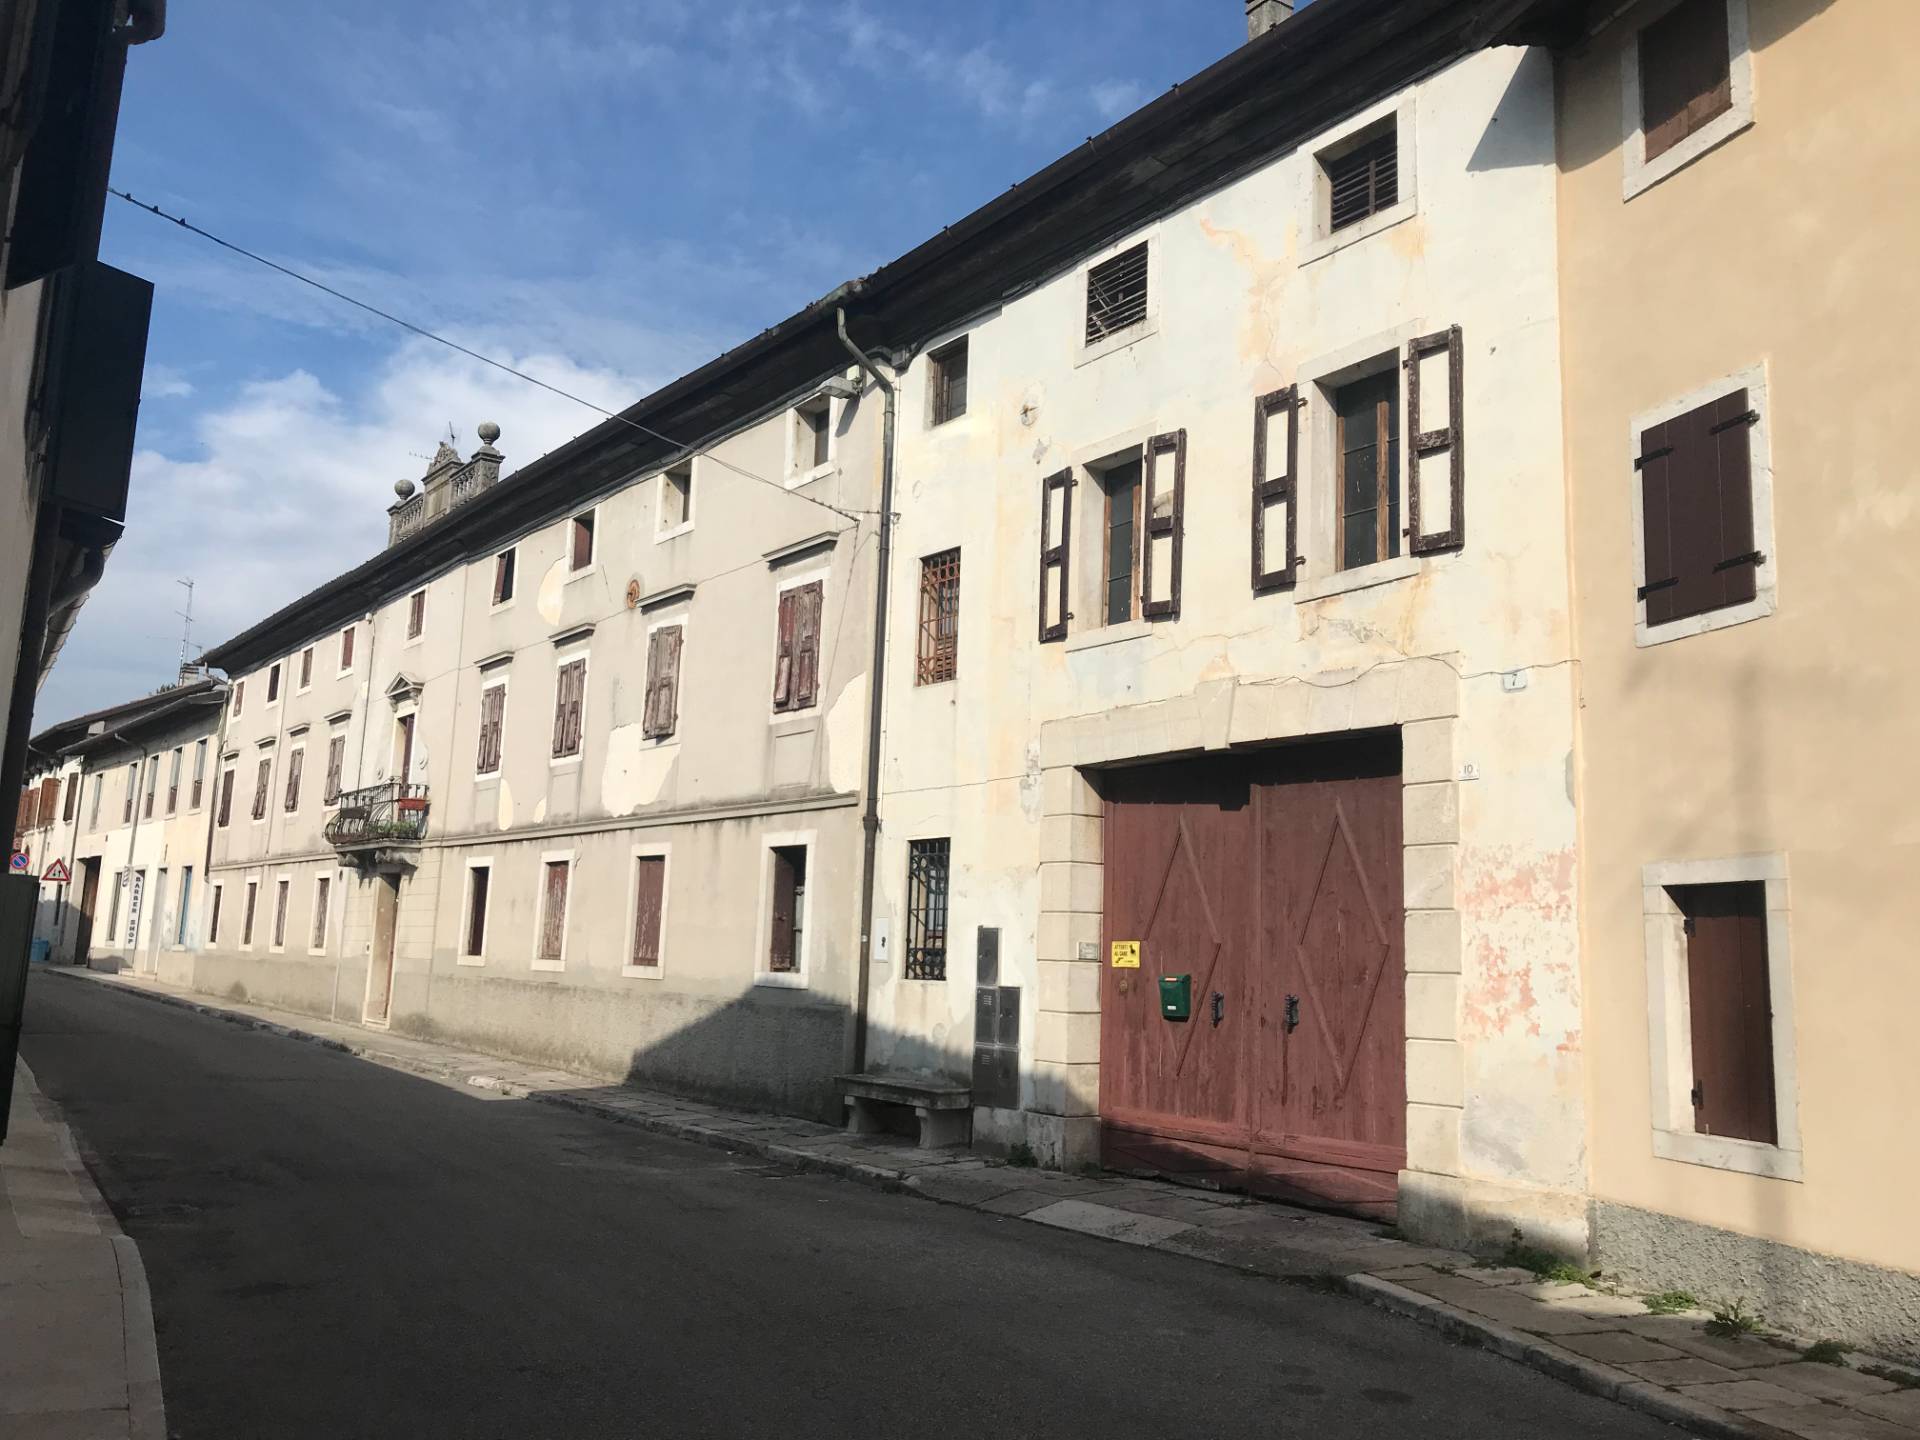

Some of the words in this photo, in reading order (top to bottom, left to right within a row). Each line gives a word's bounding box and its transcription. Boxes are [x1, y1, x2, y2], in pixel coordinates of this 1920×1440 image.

[1512, 673, 1518, 686] 7
[1464, 764, 1474, 775] 10
[131, 876, 141, 913] BARBER
[127, 919, 136, 945] SHOP
